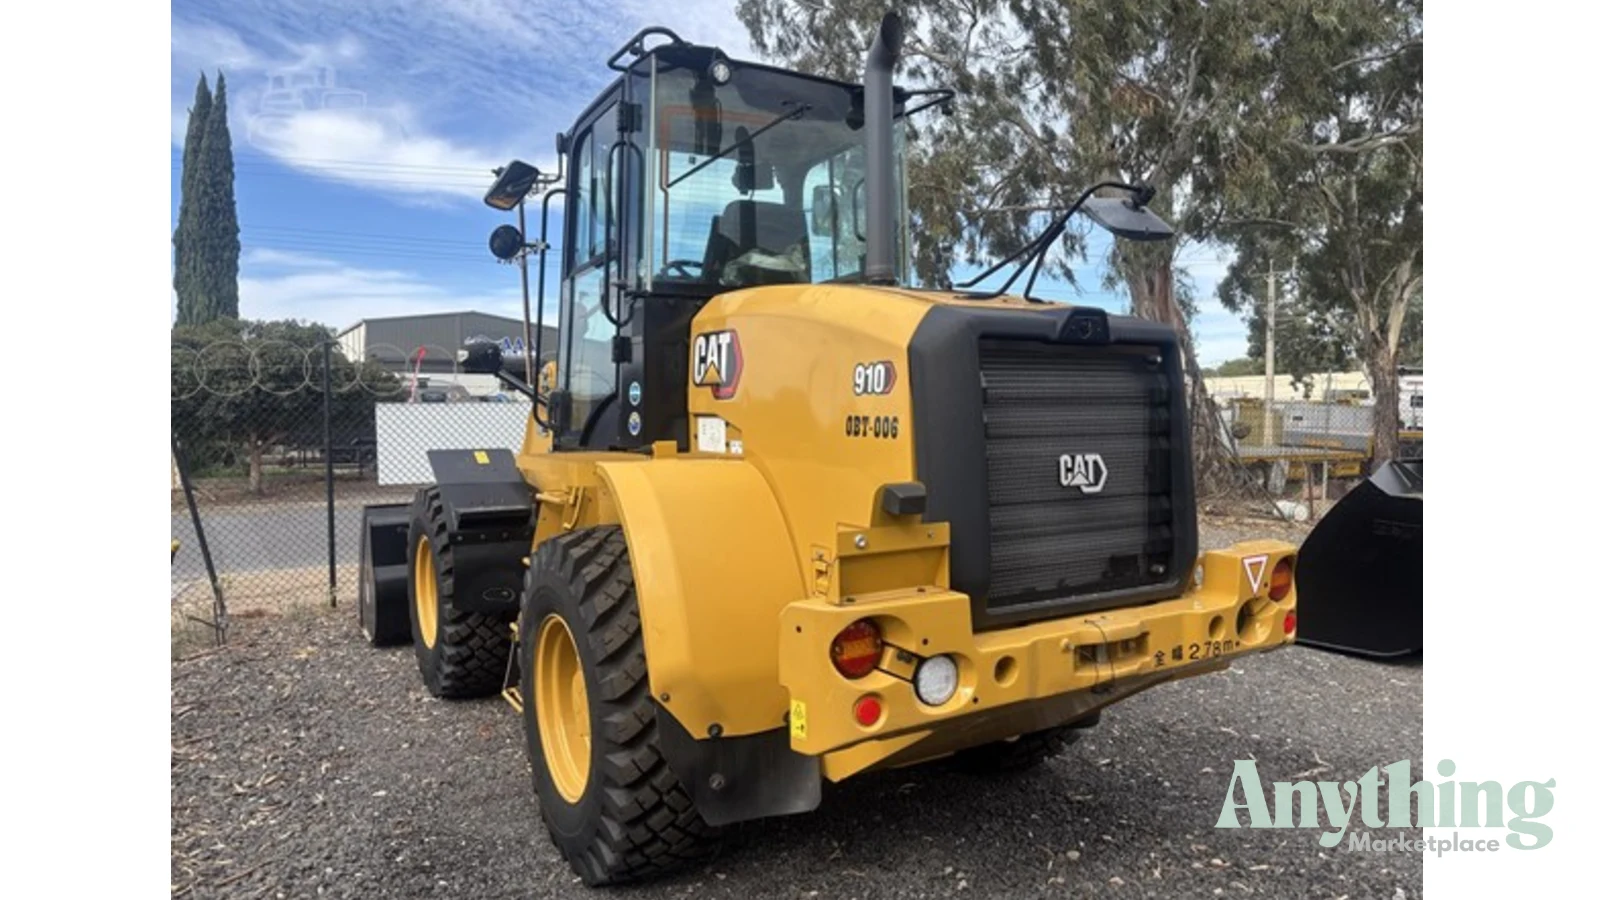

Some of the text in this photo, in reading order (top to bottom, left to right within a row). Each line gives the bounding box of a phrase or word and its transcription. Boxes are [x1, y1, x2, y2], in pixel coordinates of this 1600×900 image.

[694, 331, 731, 385] CAT
[855, 364, 885, 394] 910
[1060, 454, 1096, 486] CAT
